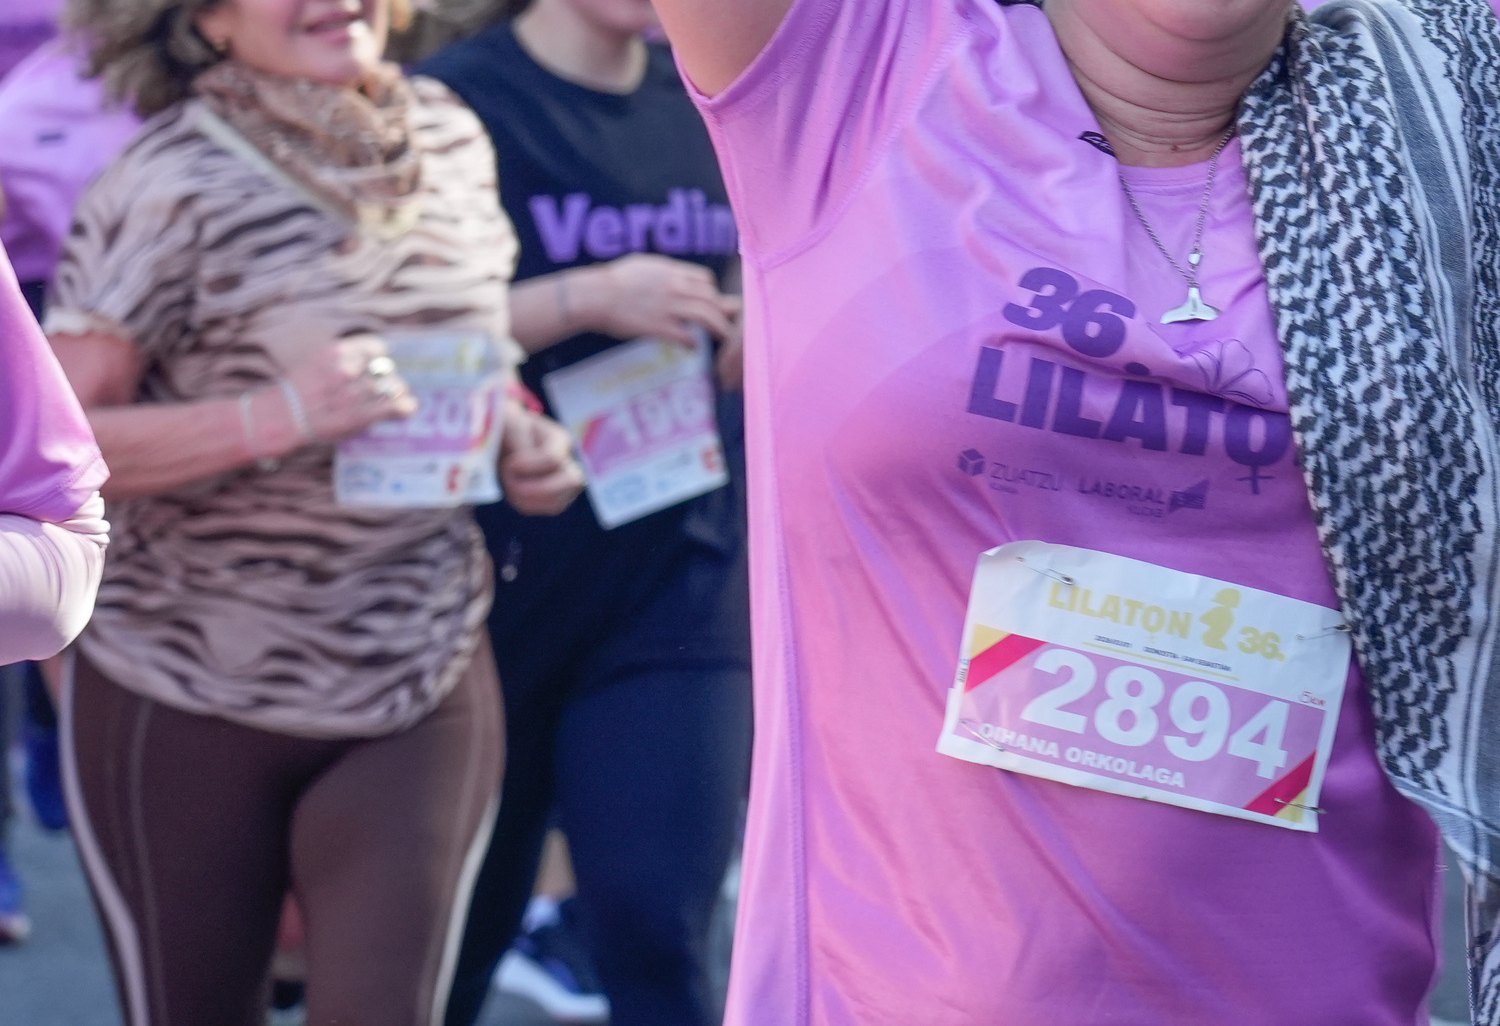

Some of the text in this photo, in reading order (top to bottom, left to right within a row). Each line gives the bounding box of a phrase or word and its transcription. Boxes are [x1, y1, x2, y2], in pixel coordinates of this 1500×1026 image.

[967, 346, 1292, 492] LILATO
[1077, 479, 1166, 505] LABORAL
[1048, 581, 1192, 643] LILATON
[1021, 647, 1289, 780] 2894
[1065, 746, 1185, 788] ORKOLAGA
